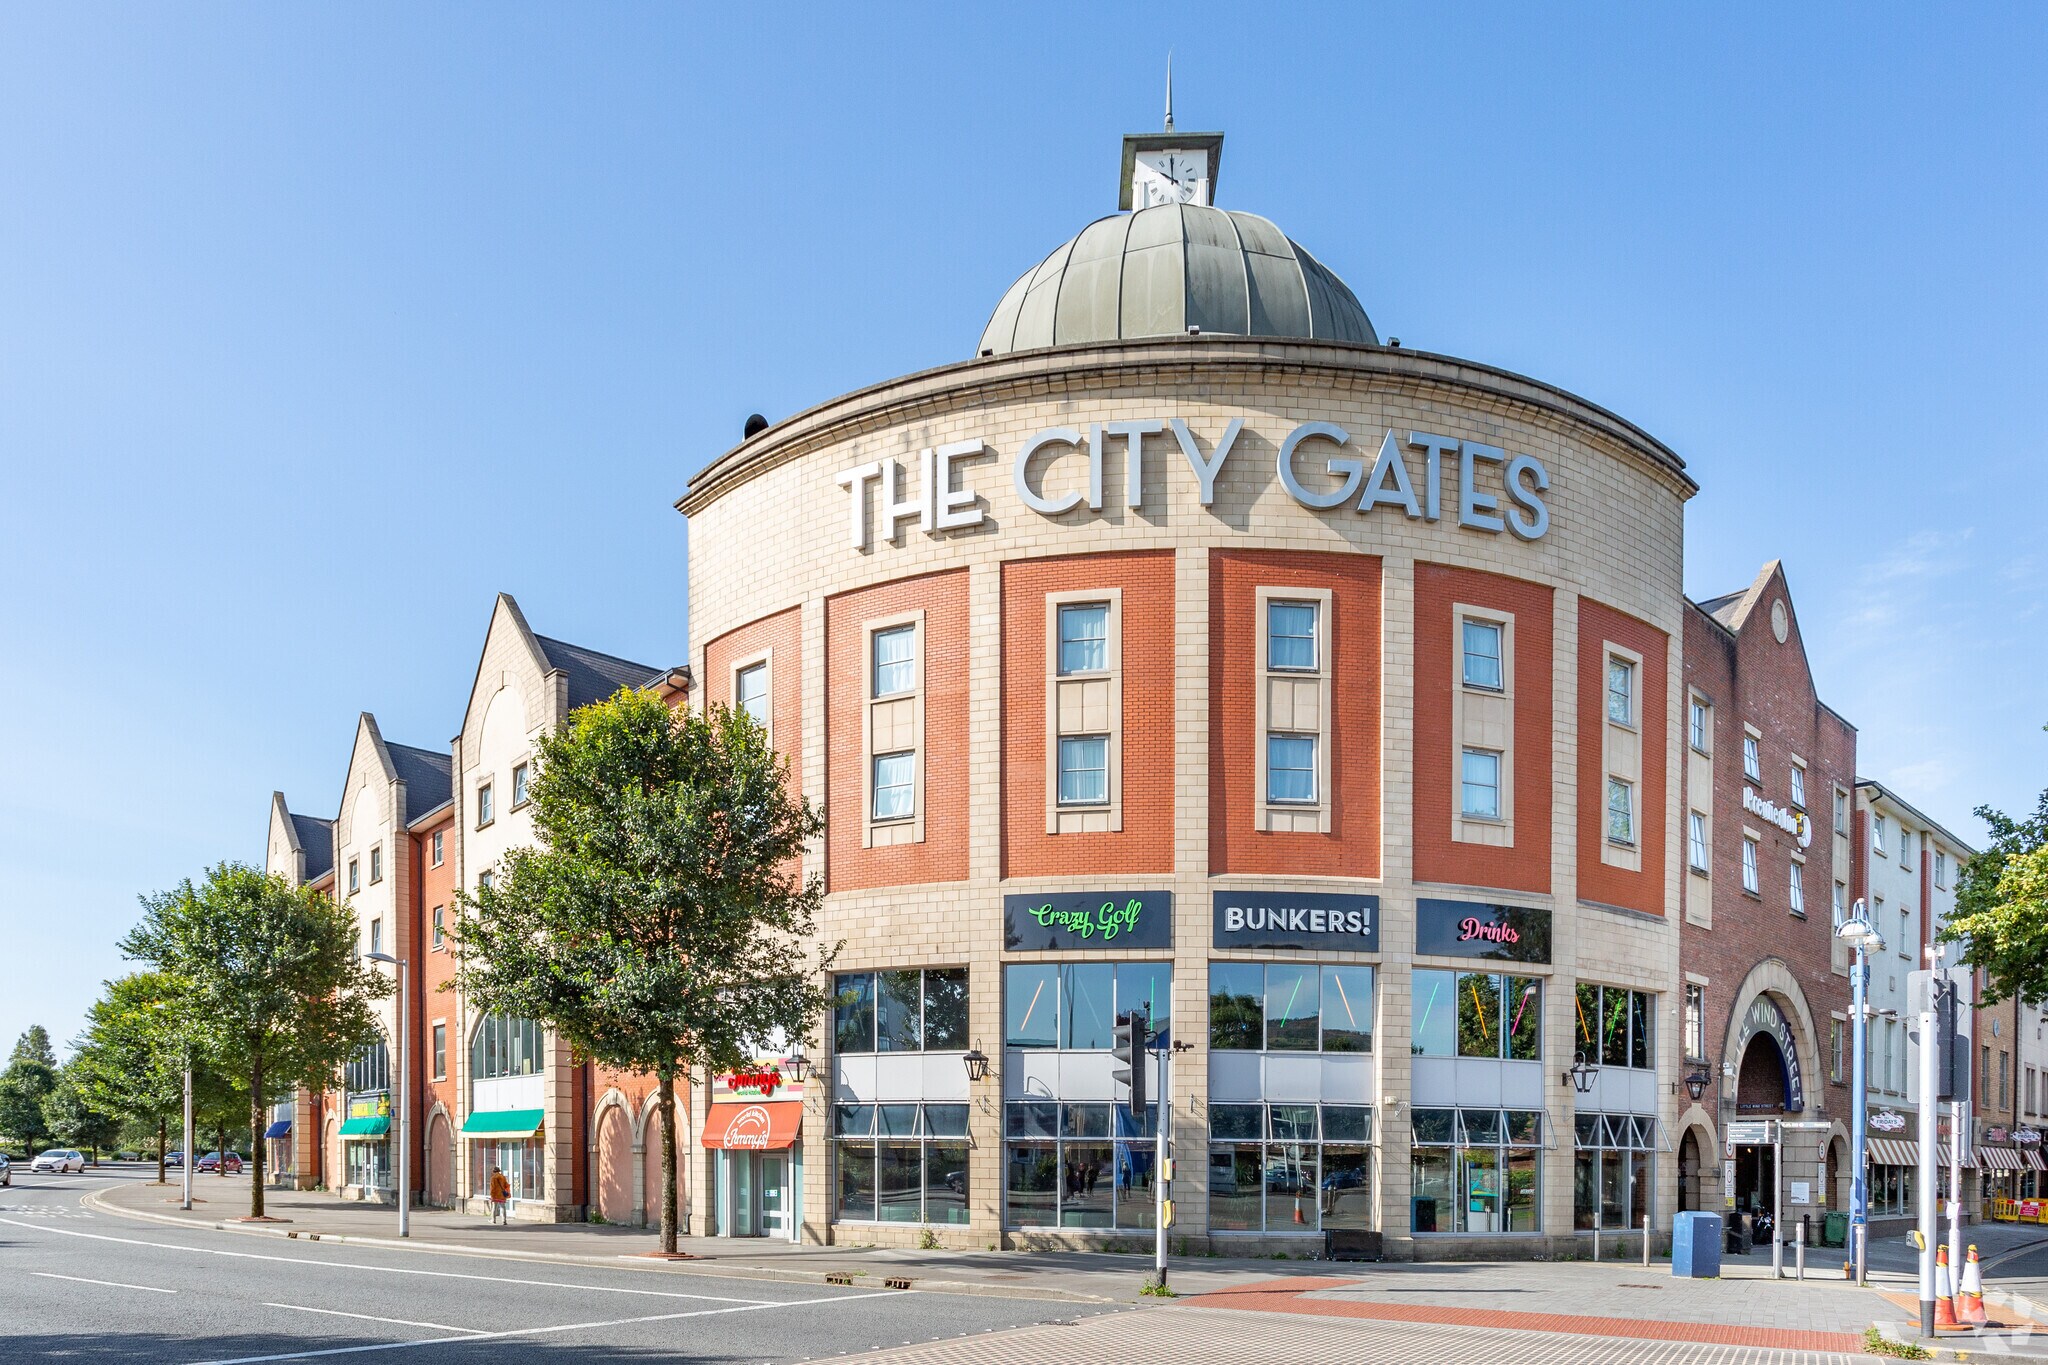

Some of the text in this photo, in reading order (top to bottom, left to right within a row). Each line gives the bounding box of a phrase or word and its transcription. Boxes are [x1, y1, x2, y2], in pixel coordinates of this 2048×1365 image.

[836, 418, 1550, 550] THE CITY GATES
[1743, 786, 1781, 826] Premier
[1028, 899, 1143, 940] Crazy Golf
[1225, 906, 1371, 936] BUNKERS!
[1460, 917, 1520, 943] Drinks
[1751, 1002, 1777, 1028] WIND
[1779, 1022, 1801, 1105] STREET
